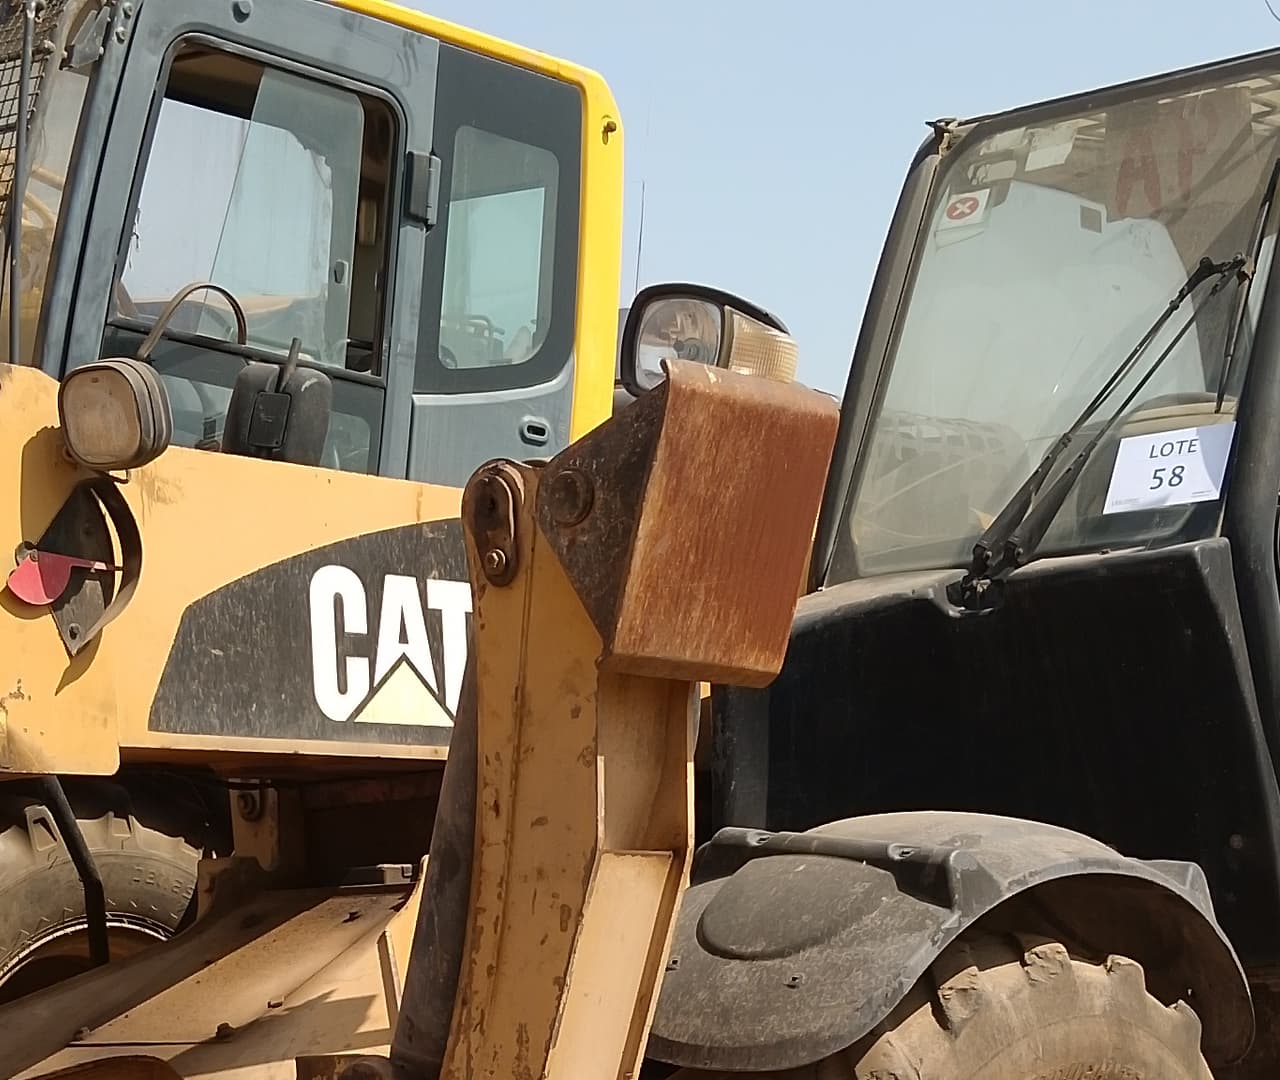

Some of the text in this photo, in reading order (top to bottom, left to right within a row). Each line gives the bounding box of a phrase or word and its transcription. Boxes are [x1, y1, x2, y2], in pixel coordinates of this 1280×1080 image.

[1149, 438, 1200, 459] LOTE
[1149, 465, 1185, 490] 58
[309, 564, 474, 727] CAT
